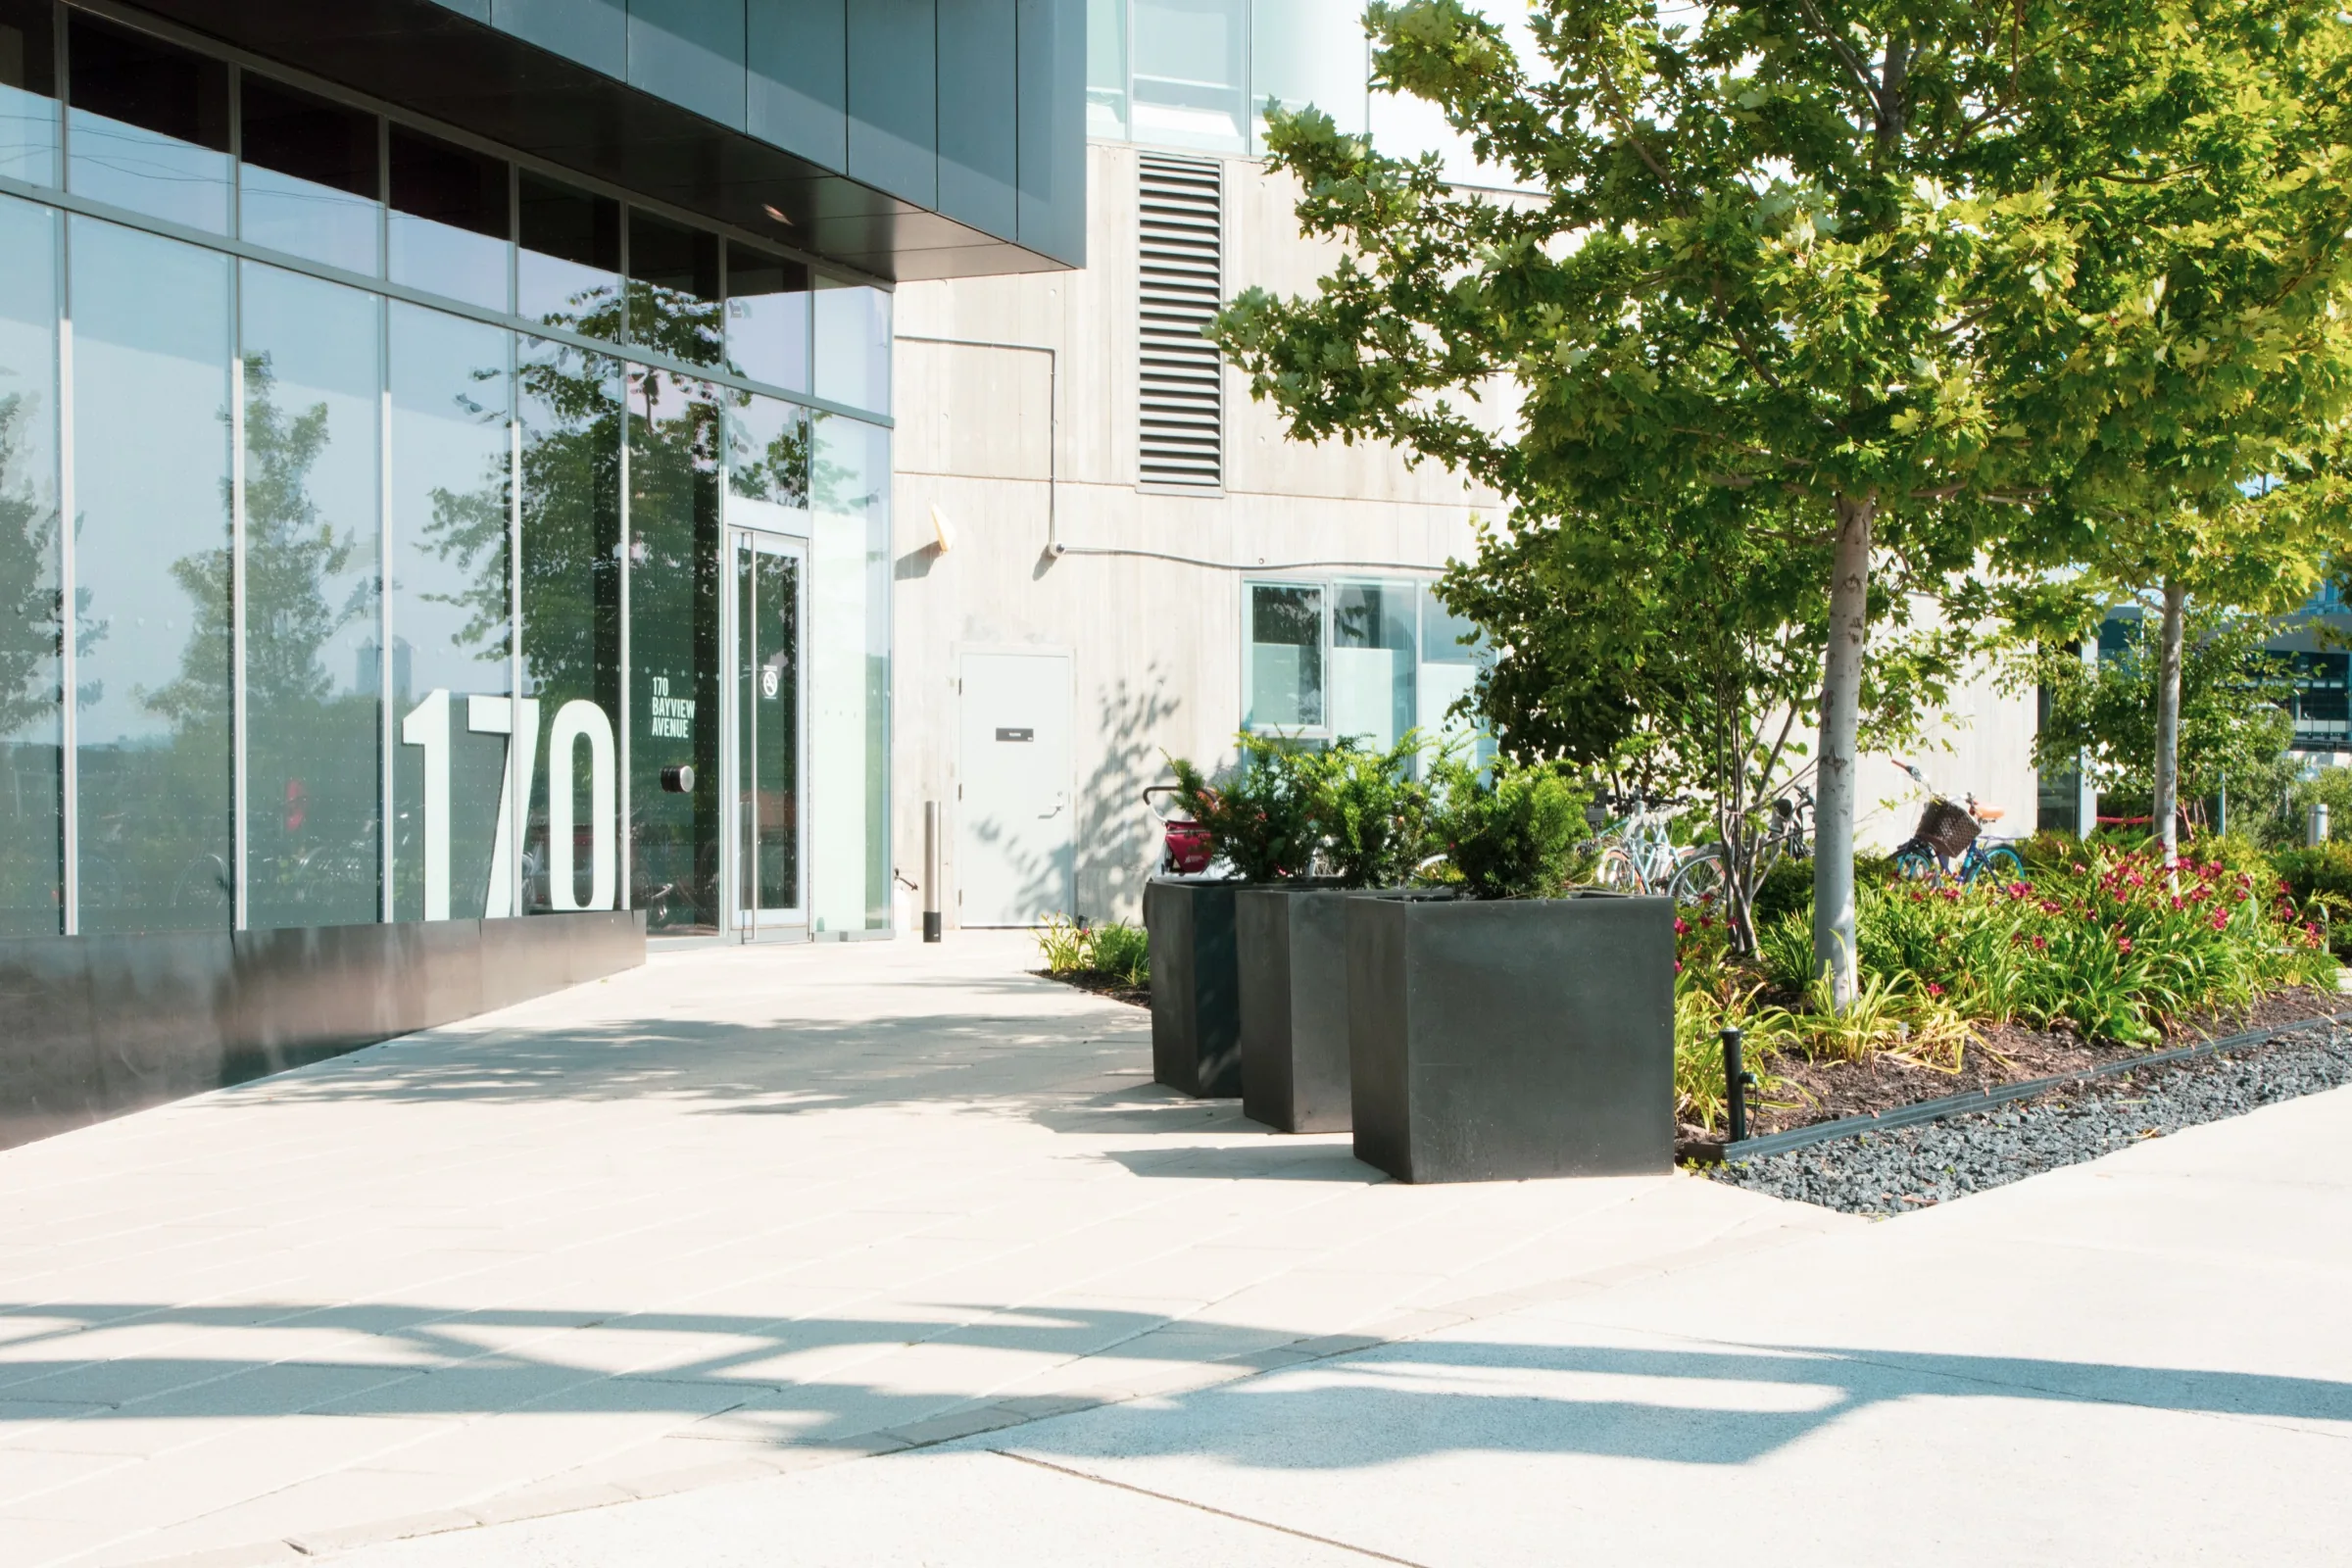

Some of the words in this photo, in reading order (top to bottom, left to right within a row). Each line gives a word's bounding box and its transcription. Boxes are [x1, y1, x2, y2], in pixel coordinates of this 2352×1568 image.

[653, 676, 669, 697] 170
[652, 697, 695, 719] BAYVIEW
[652, 717, 689, 738] AVENUE
[403, 688, 615, 920] 170
